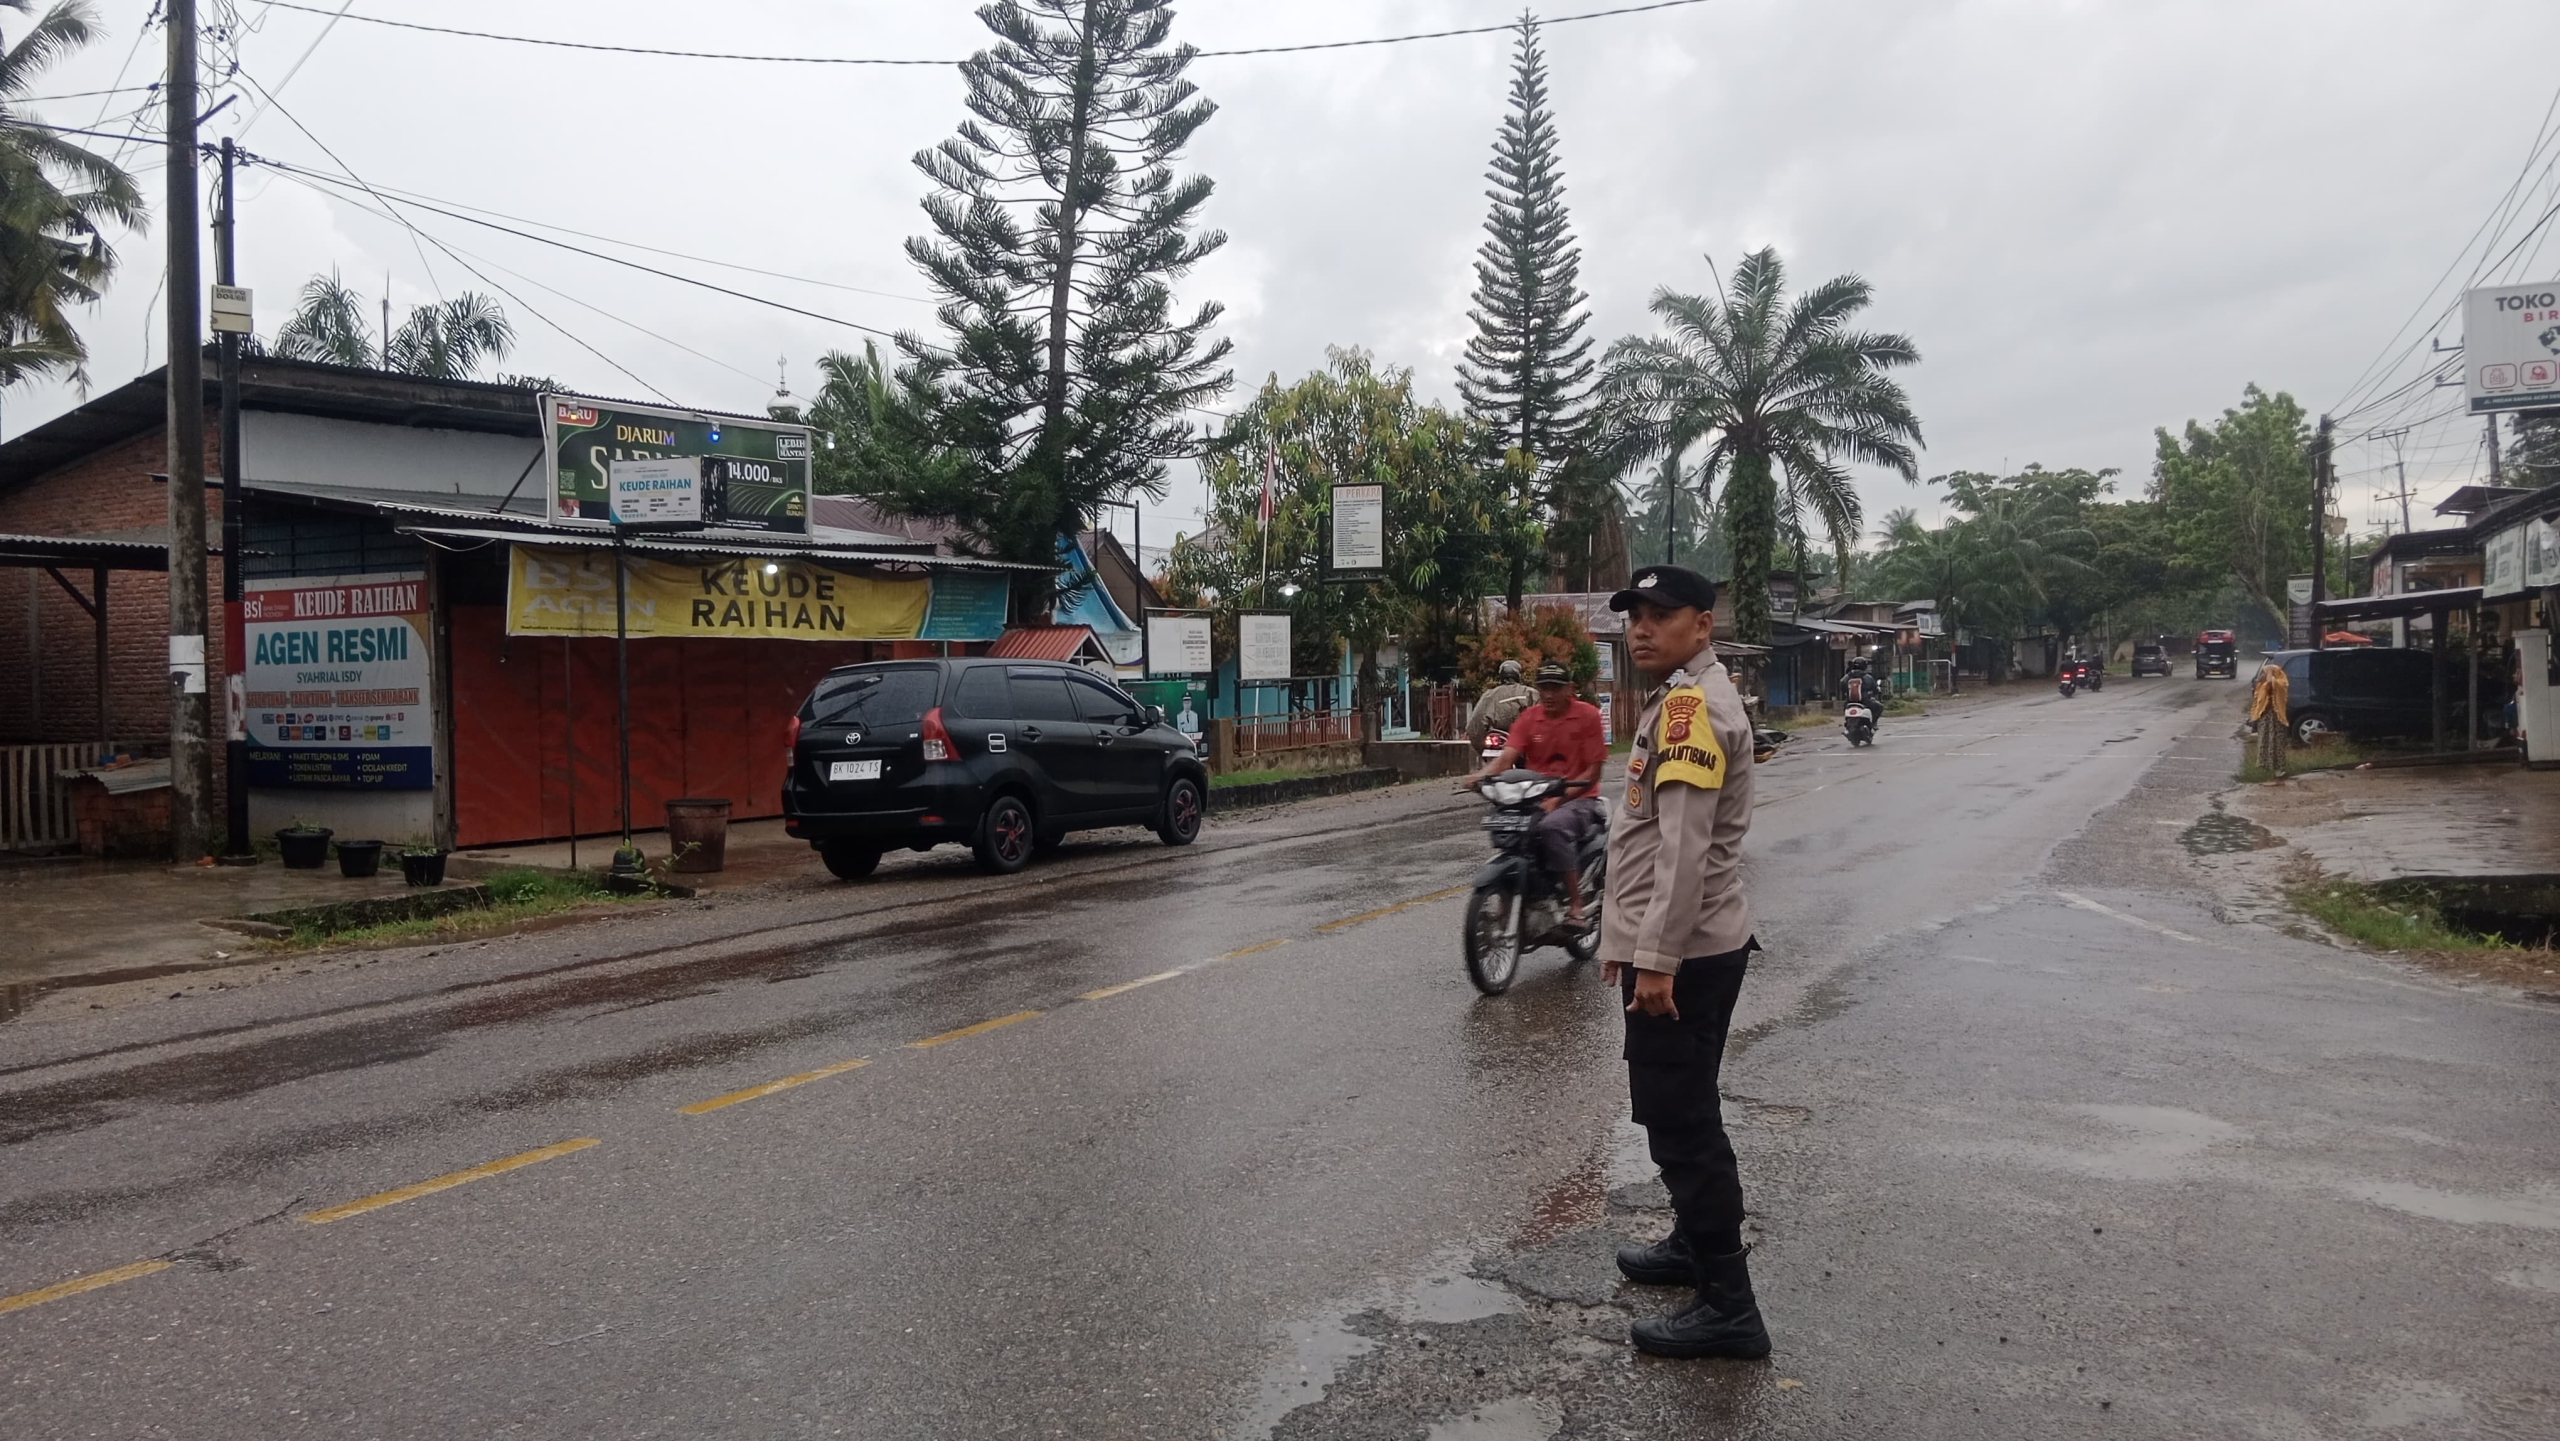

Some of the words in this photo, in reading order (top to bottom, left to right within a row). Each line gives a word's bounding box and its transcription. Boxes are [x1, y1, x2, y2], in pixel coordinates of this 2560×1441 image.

[2495, 292, 2556, 311] TOKO
[2523, 310, 2559, 322] BIR
[616, 425, 676, 446] DJARUM
[779, 438, 805, 448] LEBIH
[619, 481, 651, 492] KEUDE
[652, 479, 692, 490] RAIHAN
[1346, 487, 1381, 498] PERKARA
[701, 568, 835, 602] KEUDE
[245, 599, 263, 618] BSI
[293, 590, 346, 618] KEUDE
[351, 585, 418, 615] RAIHAN
[524, 595, 656, 616] AGEN
[691, 598, 845, 631] RAIHAN
[255, 631, 319, 665] AGEN
[327, 626, 407, 663] RESMI
[297, 672, 341, 684] SYAHRIAL
[342, 671, 362, 683] ISDY
[337, 690, 370, 706] TRANSFER
[371, 689, 398, 706] SEMUA
[398, 688, 419, 705] BANK
[316, 714, 328, 722] VISA
[293, 753, 310, 761] PAKET
[311, 753, 332, 761] TELPON
[337, 753, 349, 761] SMS
[362, 753, 380, 761] PDAM
[833, 763, 843, 774] BK
[869, 762, 879, 773] TS
[332, 774, 350, 782] BAYAR
